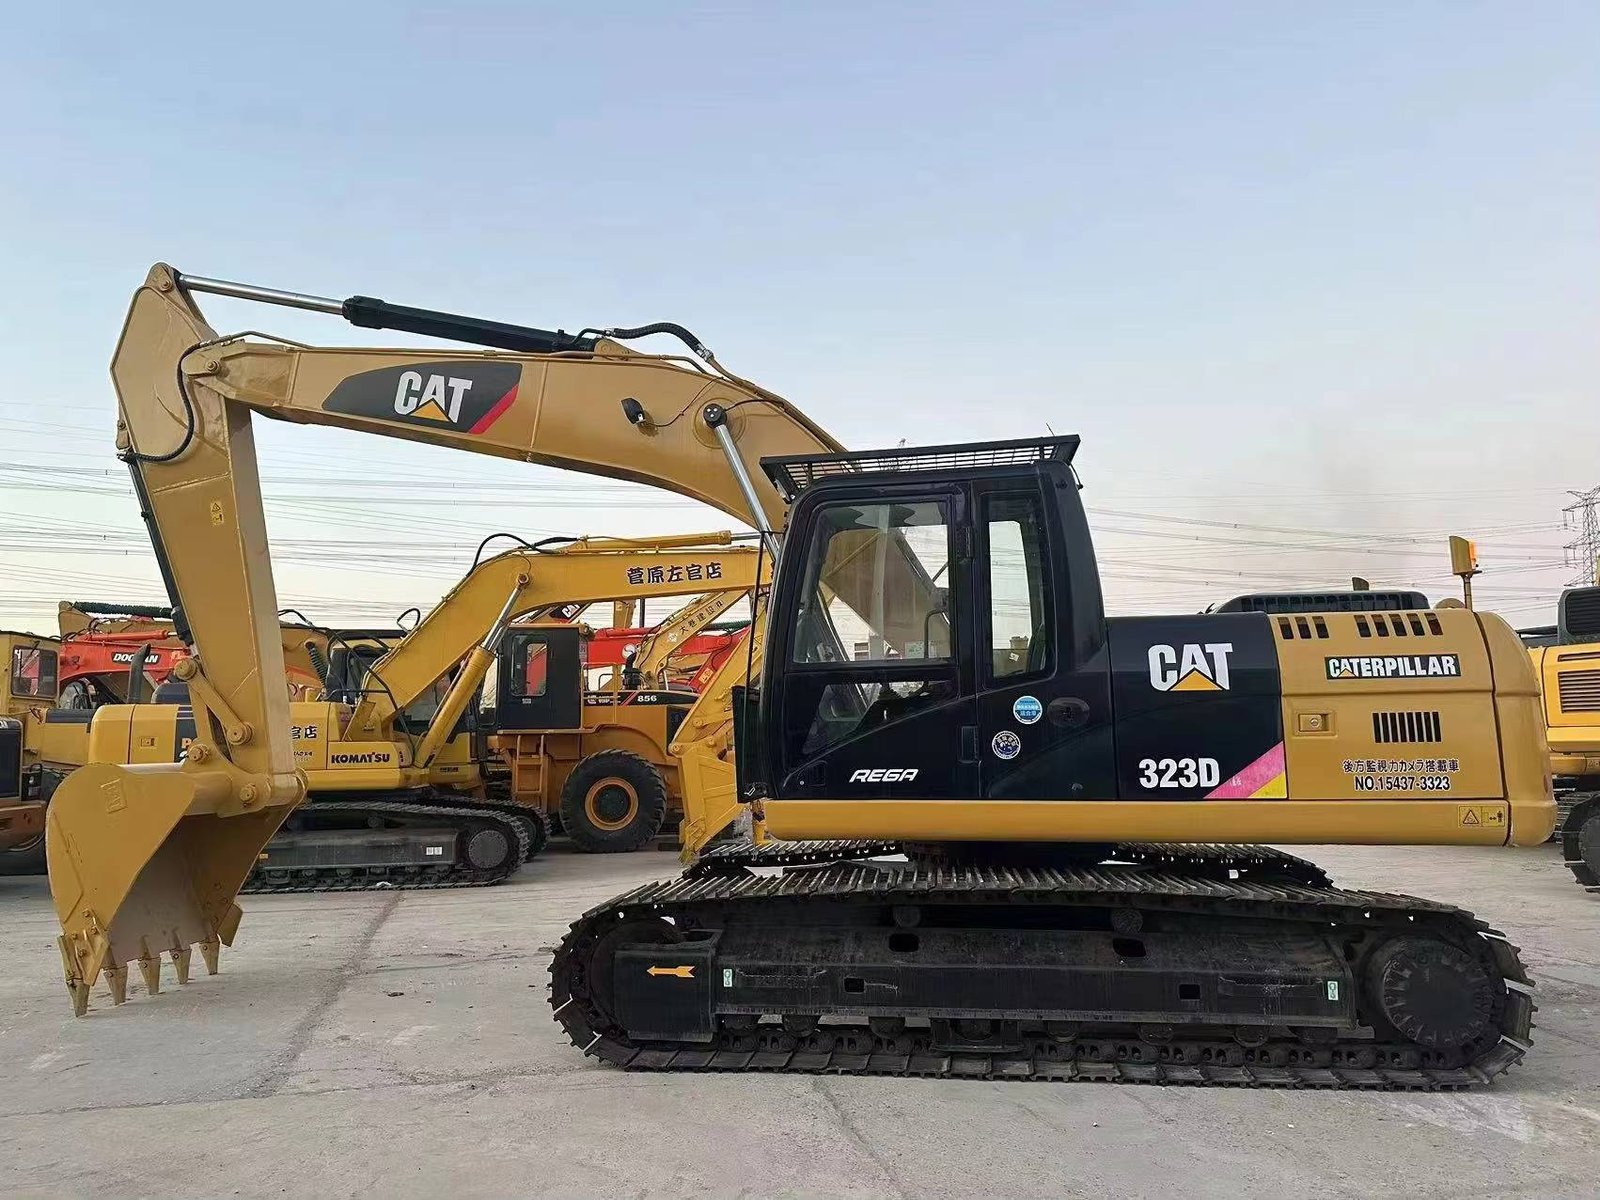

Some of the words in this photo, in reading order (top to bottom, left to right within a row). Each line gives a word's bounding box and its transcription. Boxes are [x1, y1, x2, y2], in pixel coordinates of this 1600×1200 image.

[394, 371, 473, 423] CAT
[627, 562, 722, 585] 菅原左官店
[1148, 643, 1233, 691] CAT
[1328, 656, 1457, 678] CATERPILLAR
[331, 752, 390, 764] KOMATSU
[848, 768, 920, 783] REGA
[1138, 757, 1220, 789] 323D
[1355, 776, 1451, 792] NO.15437-3323
